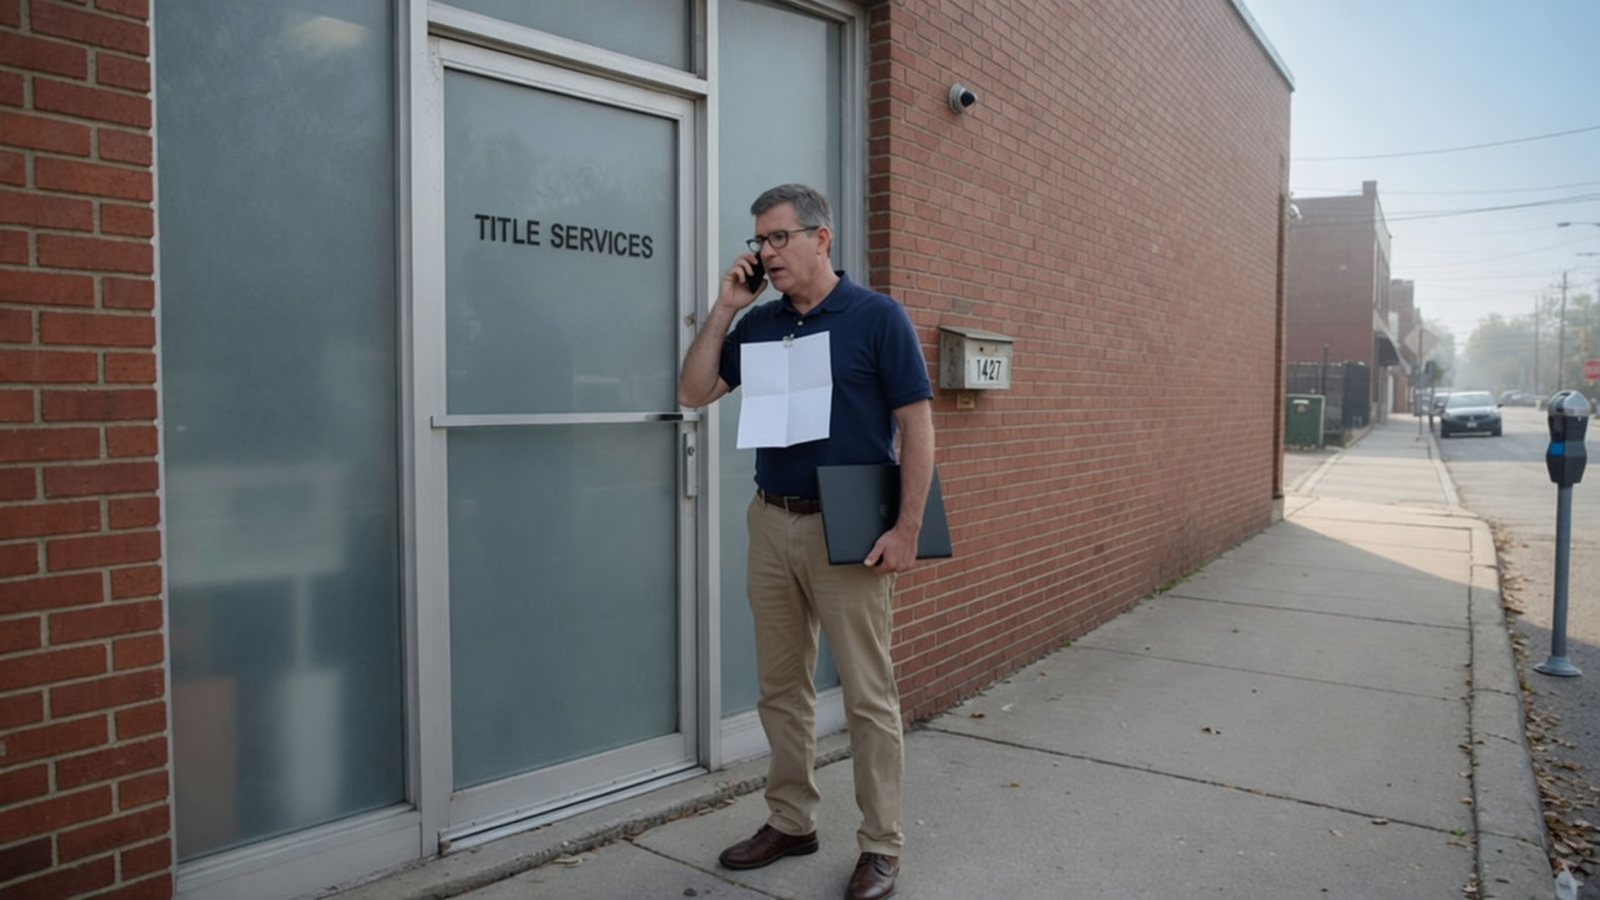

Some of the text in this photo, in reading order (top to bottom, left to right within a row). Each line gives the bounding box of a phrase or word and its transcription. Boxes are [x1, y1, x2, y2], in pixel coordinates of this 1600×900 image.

[475, 213, 653, 259] TITLE SERVICES
[976, 359, 1002, 381] 1427
